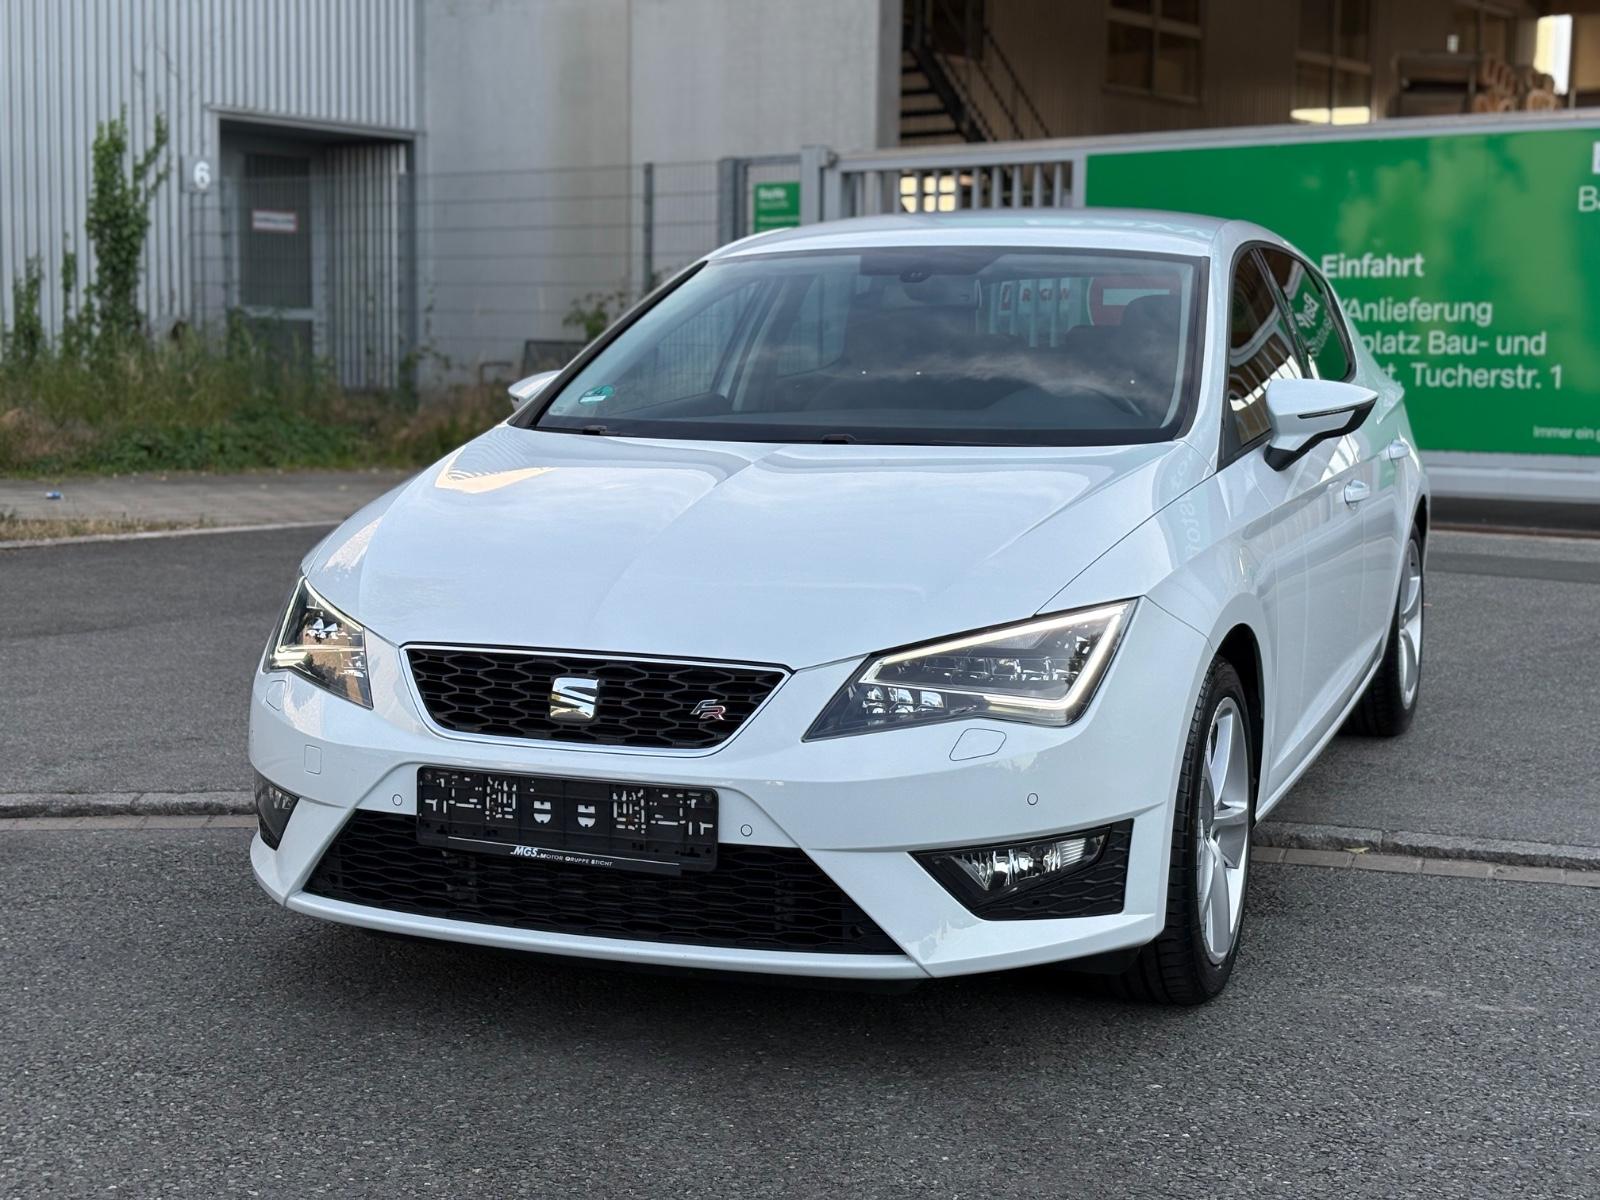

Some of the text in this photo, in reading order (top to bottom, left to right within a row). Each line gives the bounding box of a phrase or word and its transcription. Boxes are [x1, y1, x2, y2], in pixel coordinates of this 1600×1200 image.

[193, 160, 211, 190] 6
[1578, 185, 1600, 212] B
[1321, 252, 1425, 279] Einfahrt
[1427, 329, 1489, 356] Bau-
[1495, 331, 1547, 356] und
[1410, 361, 1542, 390] Tucherstr.
[1549, 364, 1563, 390] 1
